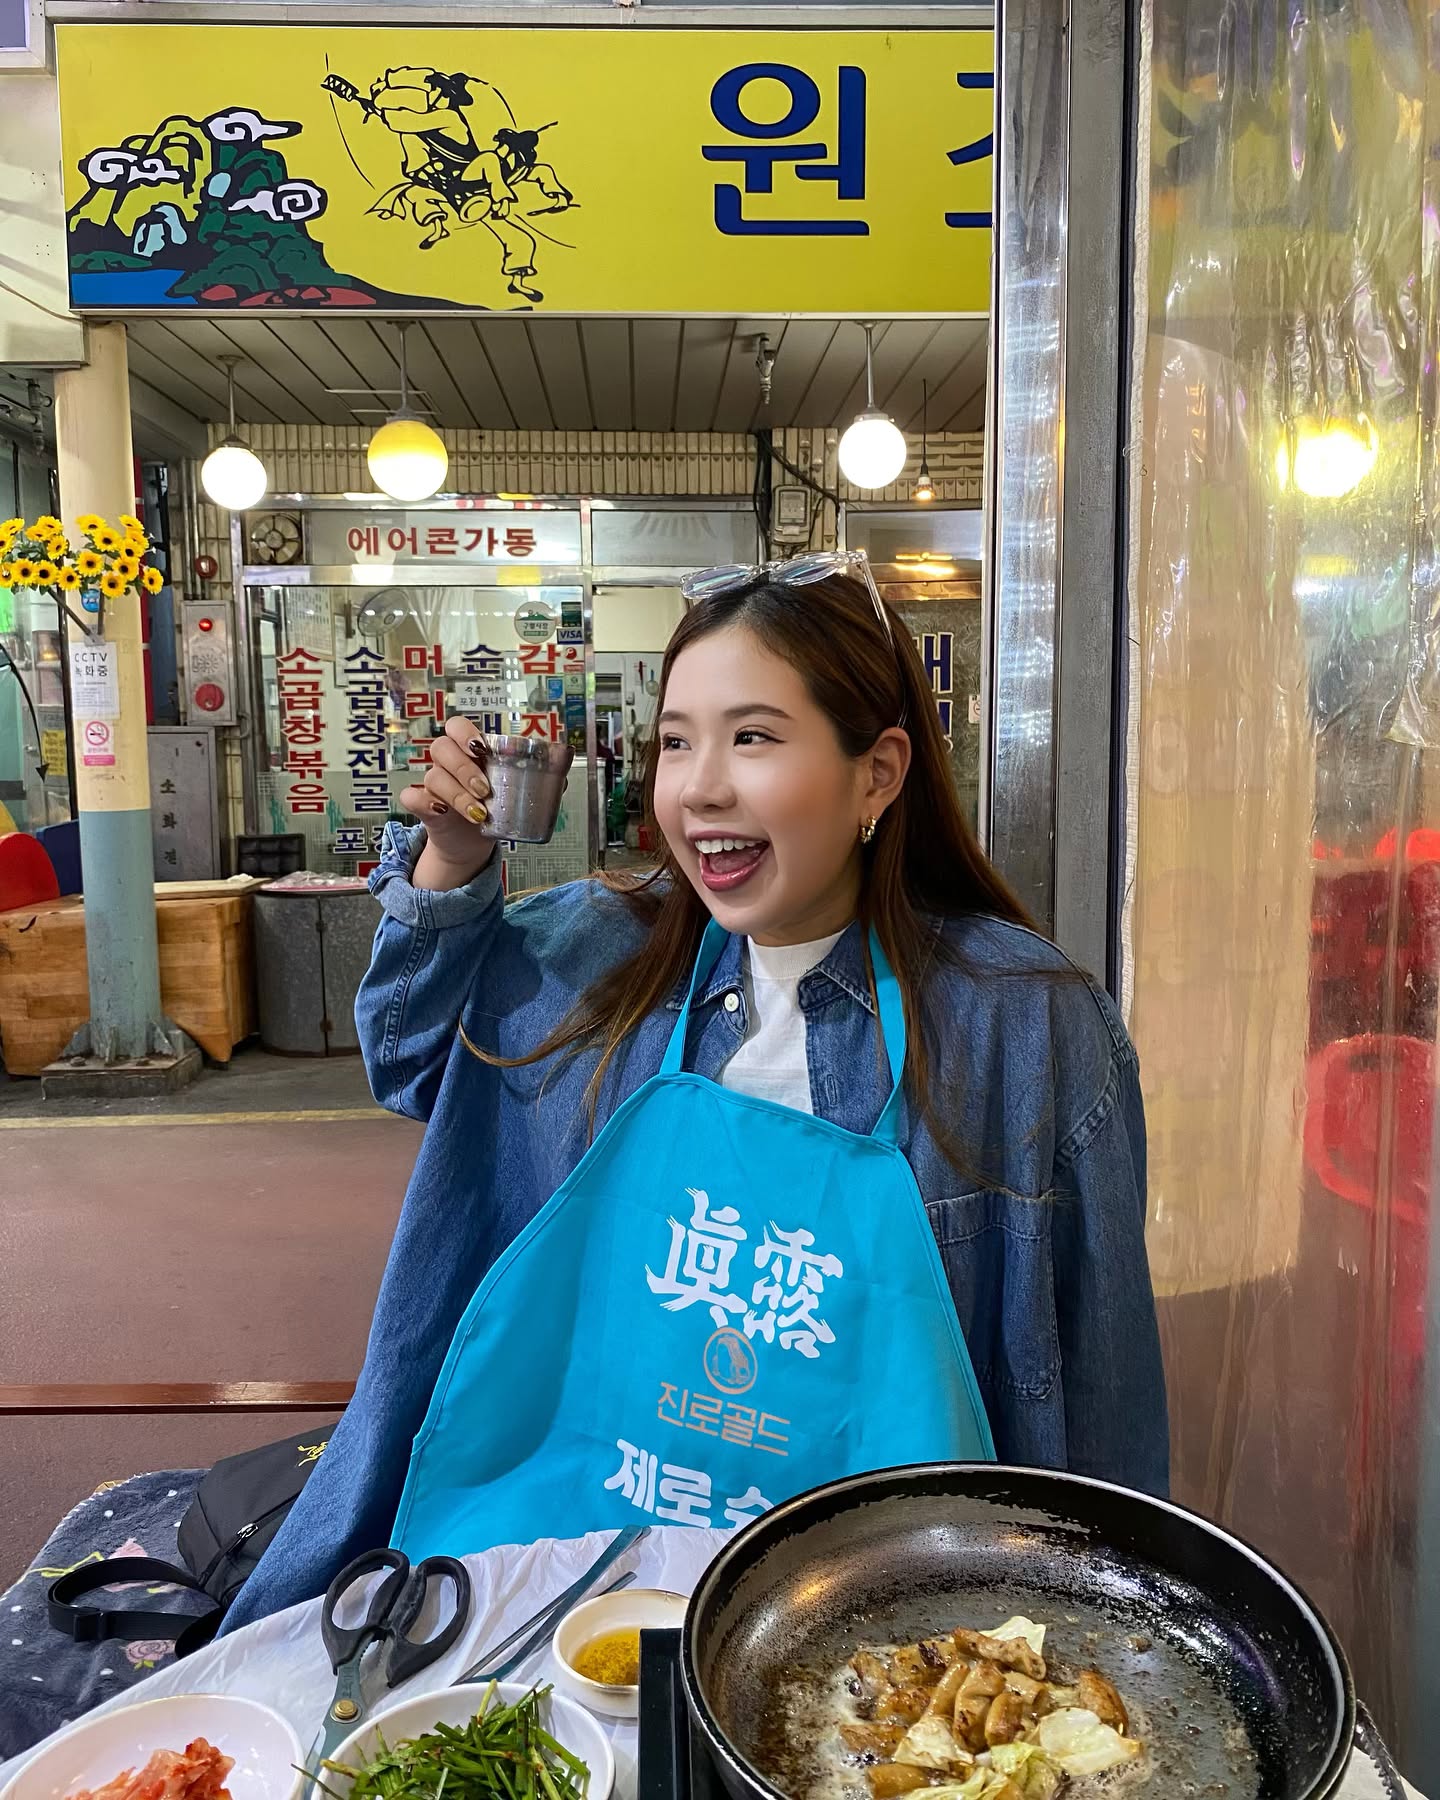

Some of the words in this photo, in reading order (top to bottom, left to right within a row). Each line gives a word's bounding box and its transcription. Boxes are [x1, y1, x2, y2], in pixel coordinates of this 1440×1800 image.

[348, 526, 537, 557] 에어콘가동
[75, 652, 107, 662] CCTV
[560, 630, 582, 639] VISA
[278, 647, 329, 815] 소곱창볶음
[344, 646, 393, 814] 소곱창전골
[657, 1381, 790, 1457] 진로골드
[604, 1438, 712, 1528] 제로
